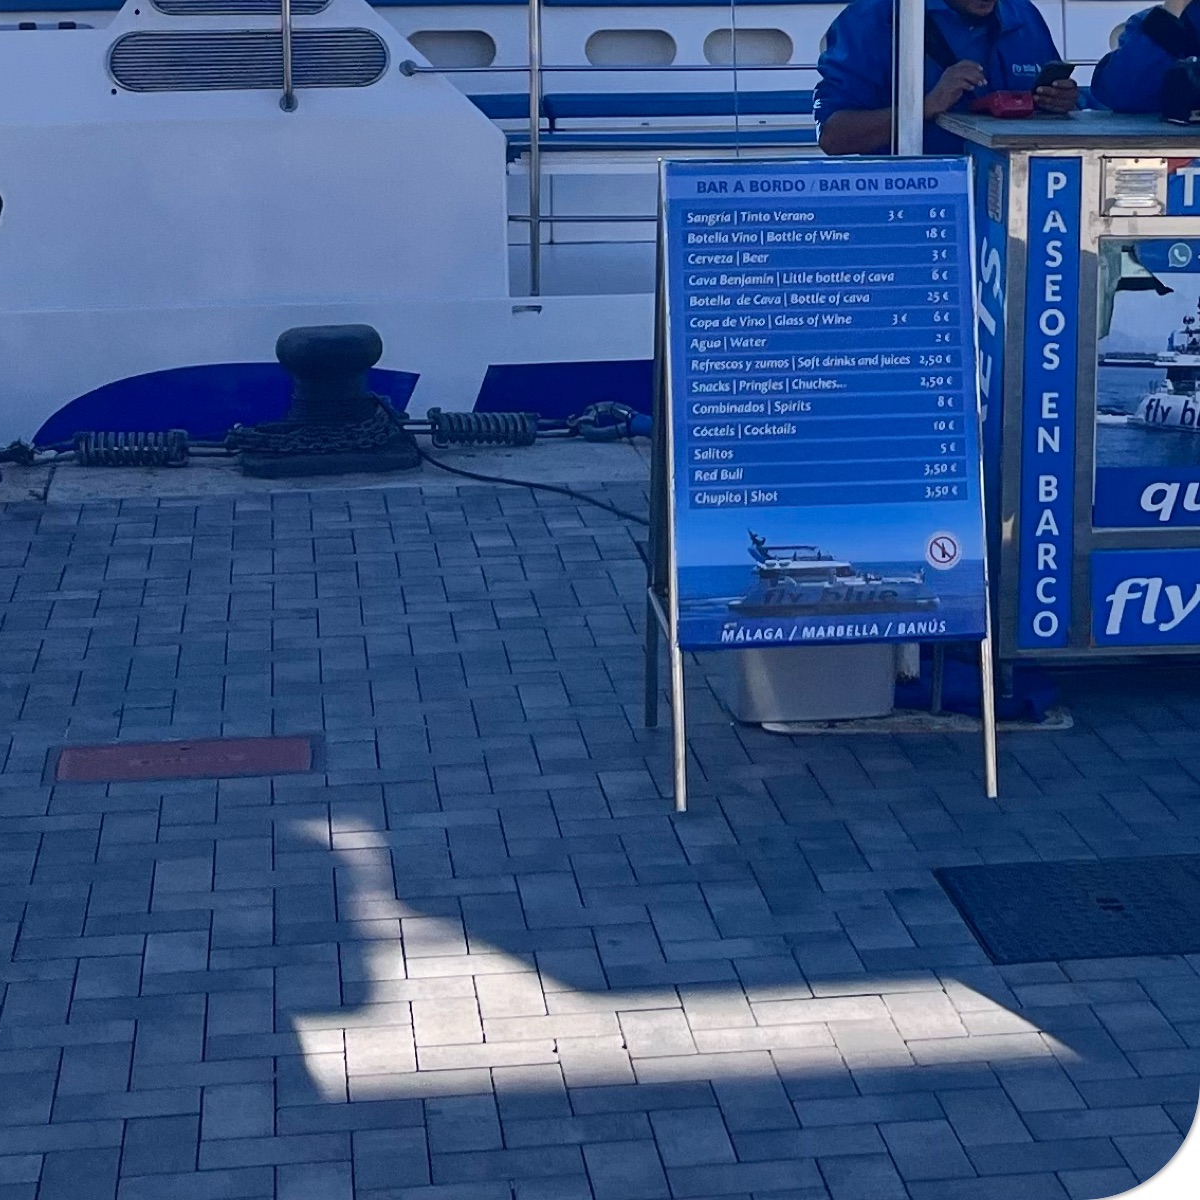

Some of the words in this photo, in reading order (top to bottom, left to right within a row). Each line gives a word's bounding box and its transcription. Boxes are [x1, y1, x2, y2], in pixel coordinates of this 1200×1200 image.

[697, 180, 728, 193] BAR
[733, 180, 744, 192] A
[750, 180, 805, 193] BORDO
[820, 179, 850, 192] BAR
[856, 179, 878, 191] ON
[884, 177, 938, 190] BOARD
[687, 210, 732, 226] Sangría
[740, 211, 770, 222] Tinto
[774, 210, 815, 221] Verano
[688, 232, 729, 244] Botella
[731, 232, 758, 243] Vino
[767, 230, 802, 242] Bottle
[805, 230, 819, 244] of
[820, 229, 850, 241] Wine
[926, 228, 938, 239] 18
[688, 253, 733, 265] Cerveza
[742, 252, 770, 263] Beer
[689, 274, 716, 286] Cava
[782, 272, 813, 284] Little
[816, 271, 851, 284] bottle
[854, 271, 867, 284] of
[868, 272, 894, 282] cava
[1039, 171, 1068, 371] PASEOS
[690, 294, 731, 307] Botella
[736, 293, 750, 305] de
[753, 293, 781, 306] Cava
[790, 292, 824, 304] Bottle
[828, 292, 840, 306] of
[844, 292, 870, 303] cava
[927, 292, 940, 302] 25
[690, 317, 720, 330] Copa
[722, 315, 737, 328] de
[739, 315, 765, 327] Vino
[775, 315, 804, 326] Glass
[807, 314, 819, 328] of
[822, 313, 852, 325] Wine
[690, 338, 721, 352] Agua
[730, 337, 767, 348] Water
[691, 358, 743, 372] Refrescos
[746, 361, 752, 372] y
[754, 359, 790, 369] zumos
[798, 356, 820, 369] Soft
[822, 355, 856, 368] drinks
[858, 355, 878, 366] and
[880, 354, 910, 368] juices
[919, 354, 942, 367] 2,50
[692, 380, 730, 392] Snacks
[739, 379, 783, 394] Pringles
[920, 376, 944, 388] 2,50
[692, 402, 765, 415] Combinados
[774, 400, 812, 414] Spirits
[1145, 398, 1172, 424] fly
[744, 423, 797, 436] Cocktails
[934, 421, 946, 431] 10
[1037, 392, 1060, 453] EN
[694, 447, 734, 460] Salitos
[694, 468, 718, 482] Red
[721, 467, 744, 480] Bull
[924, 464, 947, 476] 3,50
[695, 490, 742, 506] Chupito
[751, 489, 778, 502] Shot
[925, 486, 949, 498] 3,50
[1033, 475, 1060, 637] BARCO
[1105, 577, 1200, 635] fly
[721, 626, 783, 642] MÁLAGA
[802, 622, 879, 639] MARBELLA
[897, 618, 946, 634] BANÚS
